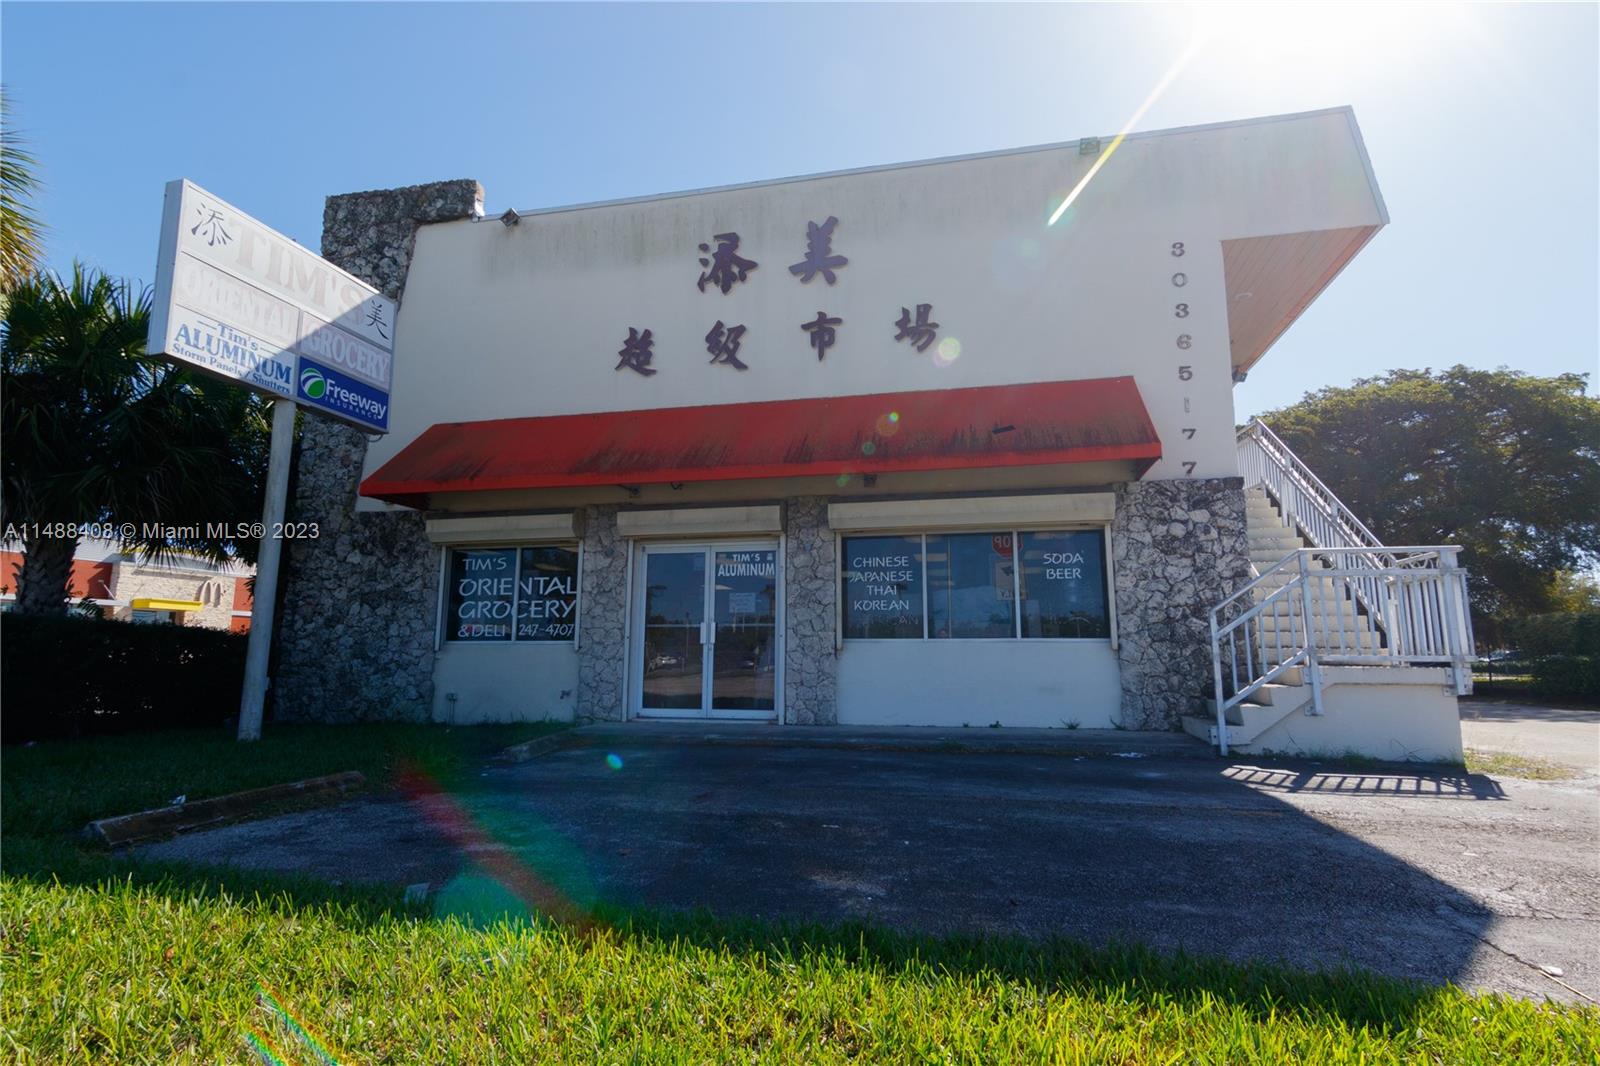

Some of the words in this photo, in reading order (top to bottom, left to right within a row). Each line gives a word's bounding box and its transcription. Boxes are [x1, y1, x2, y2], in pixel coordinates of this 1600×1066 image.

[229, 218, 365, 326] TIM'S
[218, 322, 258, 351] Tim's
[174, 323, 292, 385] ALUMINUM
[304, 323, 389, 381] GROCERY
[172, 342, 206, 363] Storm
[209, 356, 242, 377] Panels
[252, 372, 290, 394] Shutters
[326, 378, 387, 419] Freeway
[325, 396, 378, 419] INSURANCE
[462, 557, 507, 571] TIM'S
[732, 553, 761, 563] TIM'S
[853, 556, 909, 568] CHINESE
[1043, 552, 1084, 565] SODA
[718, 562, 775, 577] ALUMINUM
[849, 571, 914, 583] JAPANESE
[1047, 568, 1082, 580] BEER
[459, 577, 577, 597] ORIENTAL
[867, 585, 897, 596] THAI
[458, 600, 577, 619] GROCERY
[854, 600, 909, 611] KOREAN
[517, 623, 576, 638] 247-4707
